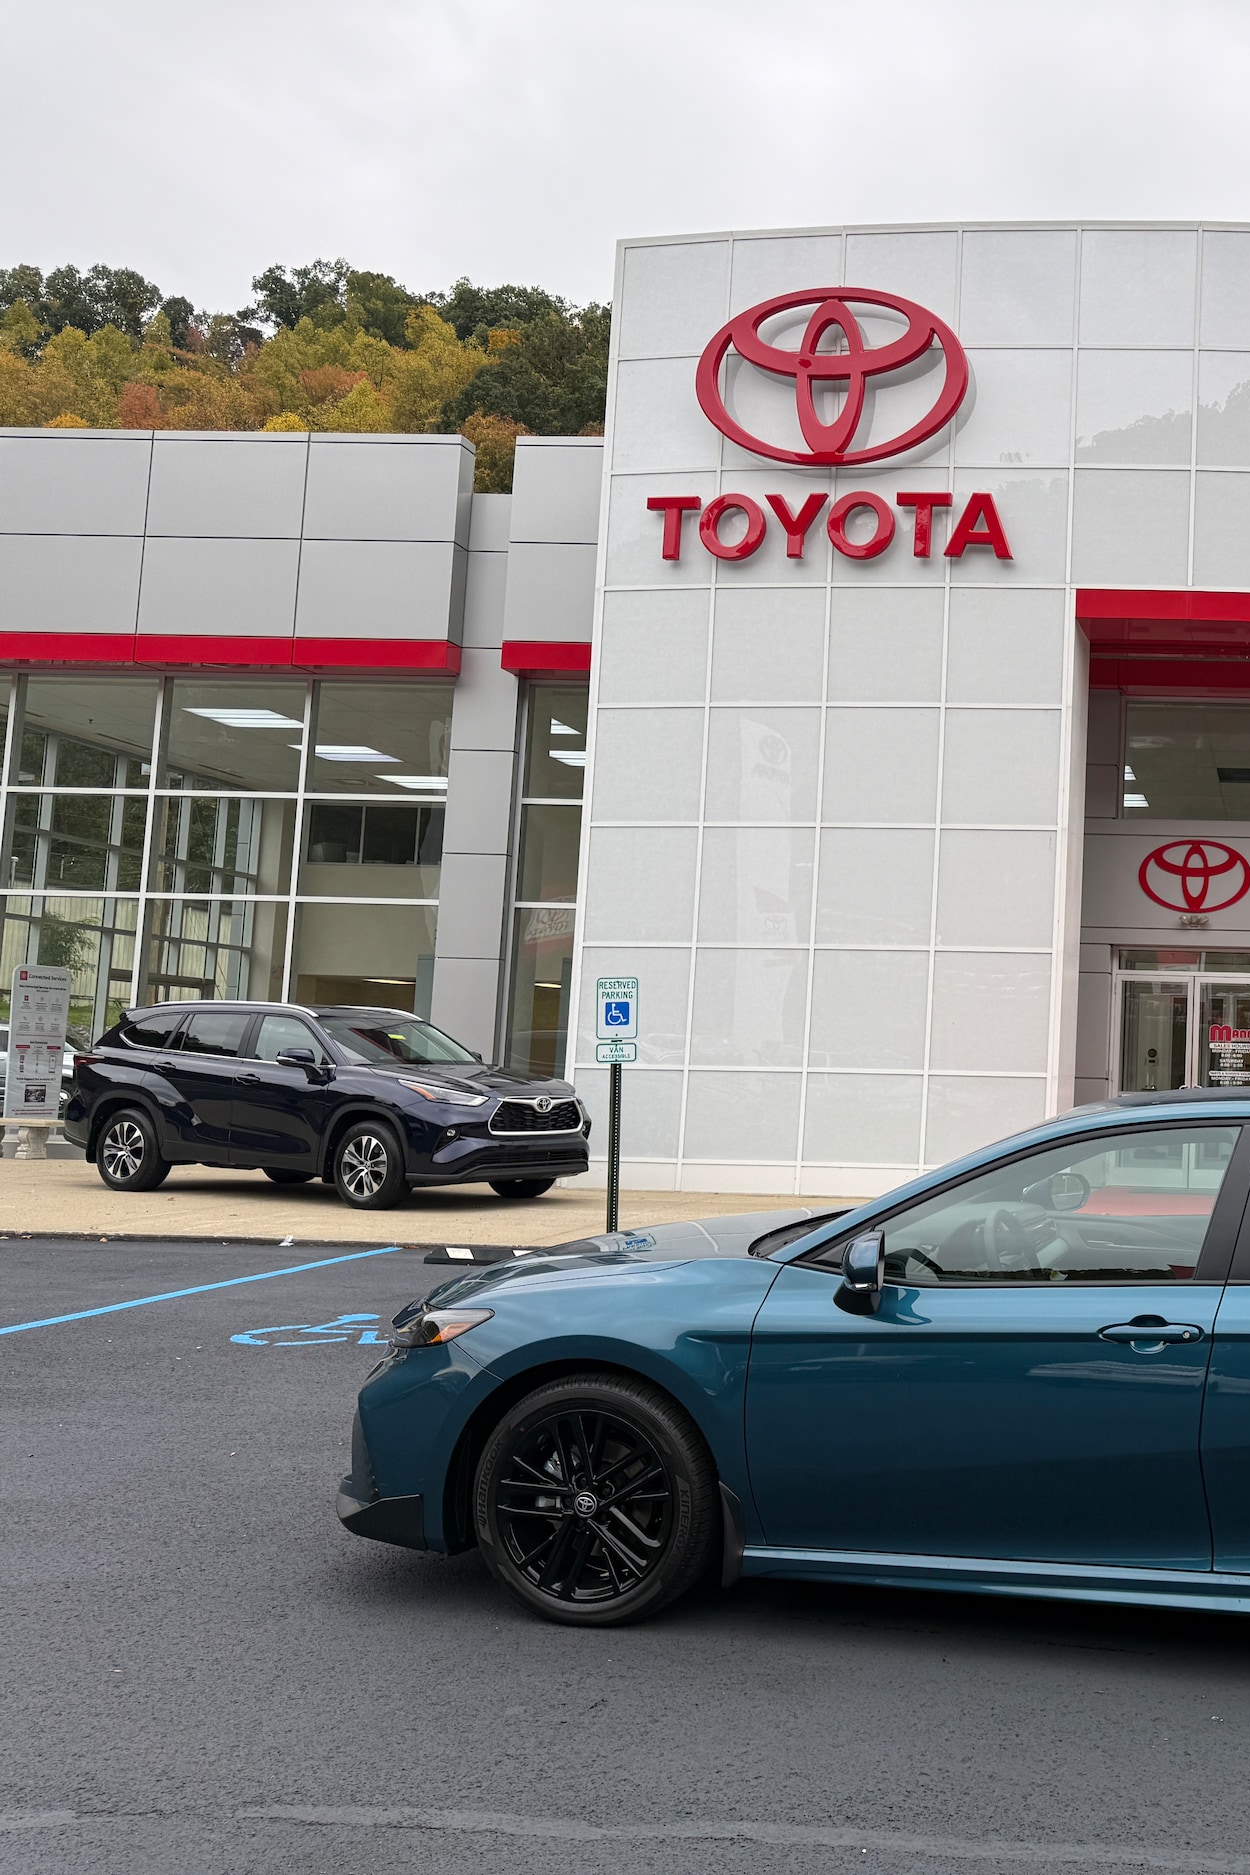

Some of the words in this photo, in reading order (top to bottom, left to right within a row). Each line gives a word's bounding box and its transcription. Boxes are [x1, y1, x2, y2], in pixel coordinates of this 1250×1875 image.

[646, 490, 1014, 561] TOYOTA
[599, 981, 636, 989] RESERVED
[602, 991, 633, 999] PARKING
